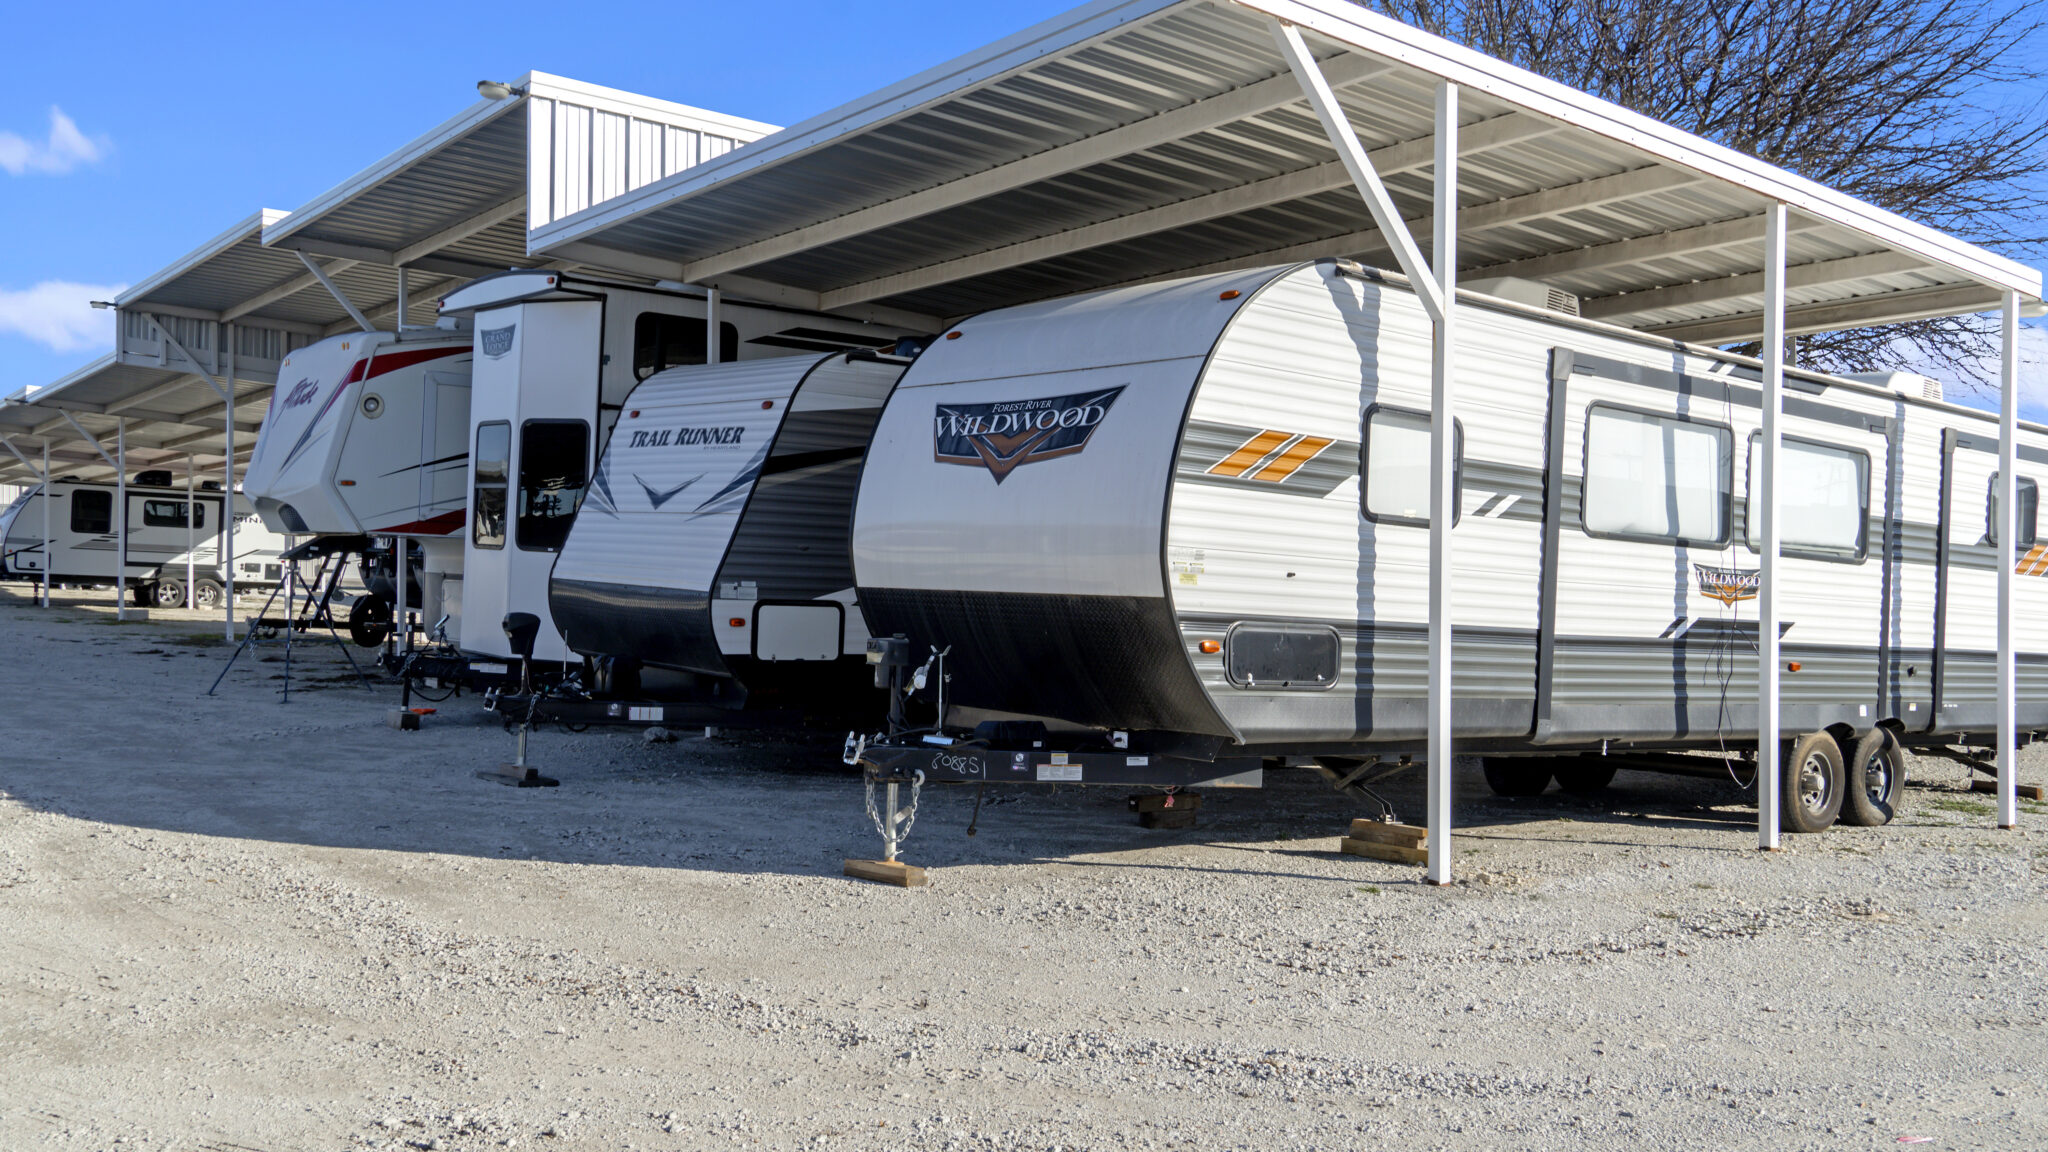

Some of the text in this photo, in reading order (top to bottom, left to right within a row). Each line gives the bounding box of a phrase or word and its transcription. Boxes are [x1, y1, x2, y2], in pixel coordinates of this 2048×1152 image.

[485, 331, 511, 343] GRAND
[486, 341, 510, 353] LODGE
[992, 400, 1053, 413] FOREST RIVER
[935, 405, 1105, 438] WILDWOOD
[629, 426, 745, 448] TRAIL RUNNER
[1696, 570, 1760, 587] WILDWOOD
